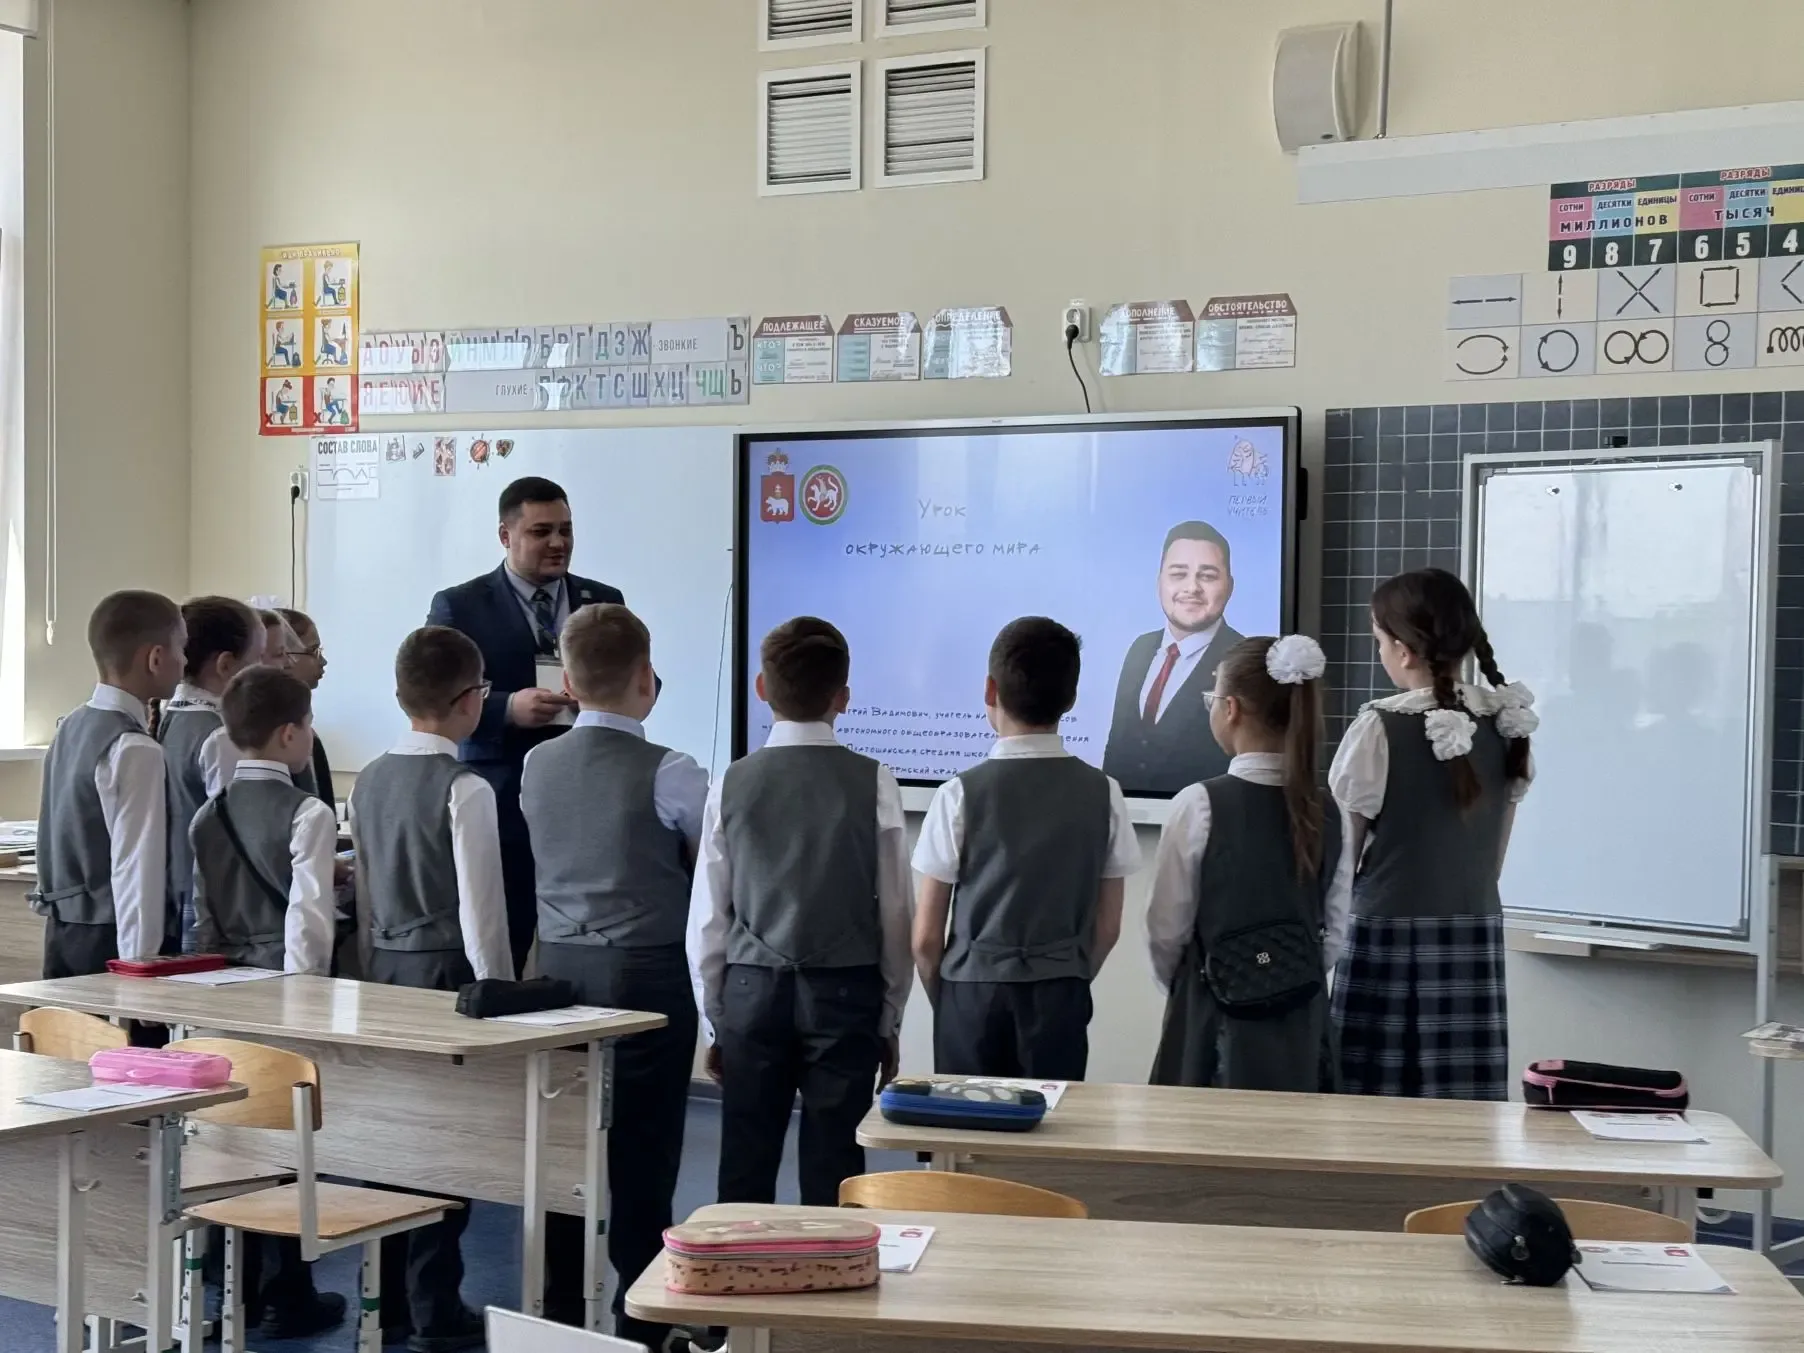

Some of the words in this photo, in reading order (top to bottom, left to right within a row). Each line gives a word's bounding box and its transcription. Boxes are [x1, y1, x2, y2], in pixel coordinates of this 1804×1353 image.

[1720, 167, 1771, 181] РАЗРЯДЫ
[1588, 179, 1636, 192] РАЗРЯДЫ
[1772, 185, 1804, 196] ЕДИНИЦ
[1637, 195, 1677, 206] ЕДИНИЦЫ
[1689, 192, 1715, 202] СОТНИ
[1729, 189, 1765, 200] ДЕСЯТКИ
[1559, 203, 1584, 212] СОТНИ
[1596, 200, 1632, 210] ДЕСЯТКИ
[1714, 206, 1775, 223] ТЫСЯЧ
[1560, 215, 1668, 233] МИЛЛИОНОВ
[1563, 245, 1577, 269] 9
[1605, 242, 1619, 266] 8
[1648, 238, 1663, 262] 7
[1694, 235, 1709, 259] 6
[1736, 232, 1750, 256] 5
[1782, 229, 1798, 253] 4
[1208, 300, 1287, 313] ОБСТОЯТЕЛЬСТВО
[763, 320, 825, 333] ПОДЛЕЖАЩЕЕ
[854, 317, 905, 328] СКАЗУЕМОЕ
[658, 338, 698, 351] ЗВОНКИЕ
[495, 383, 528, 395] ГЛУХИЕ
[317, 440, 348, 455] СОСТАВ
[350, 439, 377, 453] СЛОВА
[917, 498, 967, 519] Урок
[847, 707, 868, 715] трий
[901, 727, 997, 740] общеобразовател
[963, 751, 989, 759] школ
